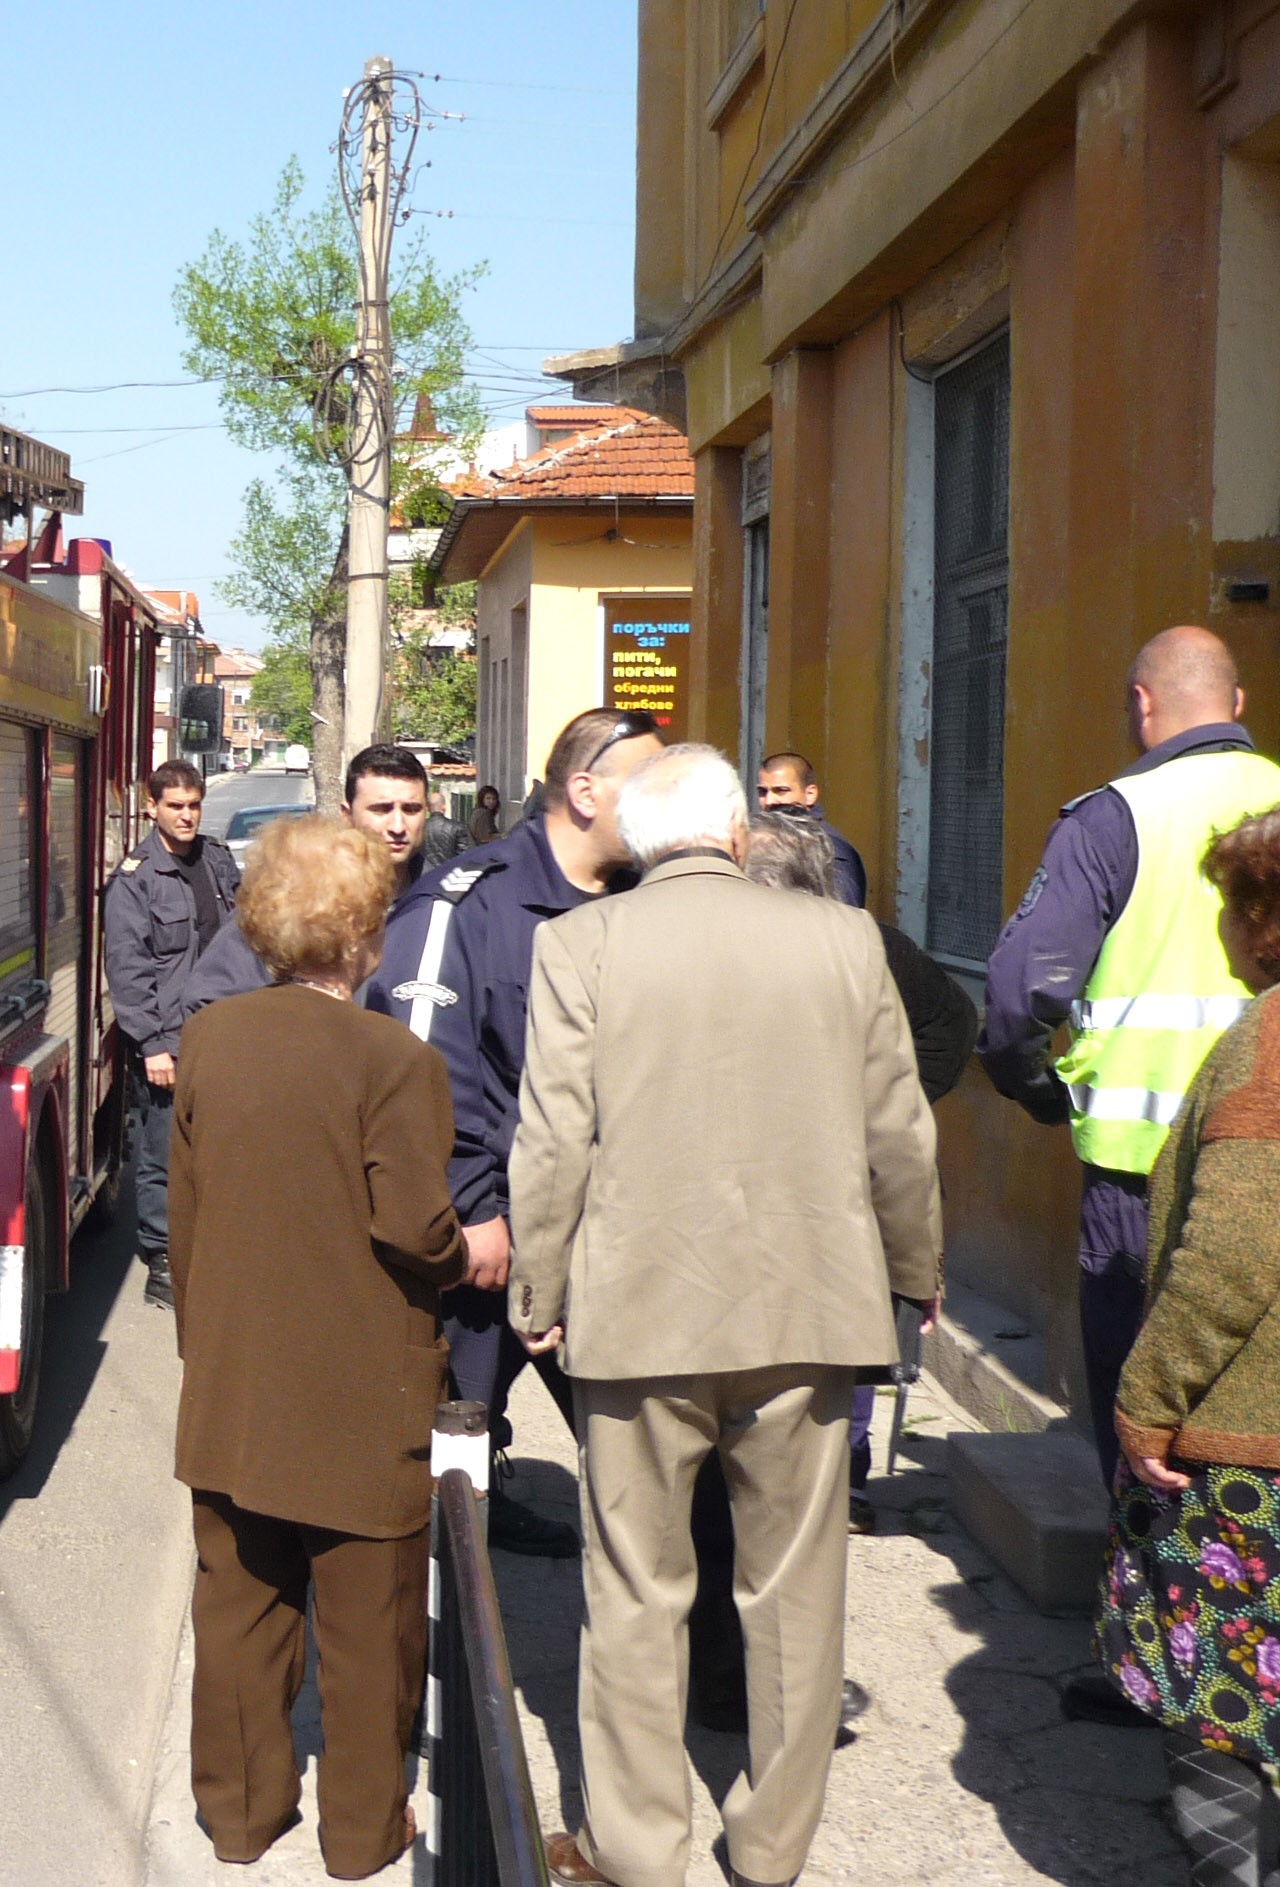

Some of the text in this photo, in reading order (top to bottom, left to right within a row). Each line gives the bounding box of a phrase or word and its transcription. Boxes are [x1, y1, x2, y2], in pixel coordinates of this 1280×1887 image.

[612, 622, 690, 636] поръчки
[637, 636, 665, 647] за:
[612, 652, 661, 665] пити,
[612, 666, 677, 677] погачи
[613, 682, 674, 695] обредни
[615, 699, 673, 710] хлябове
